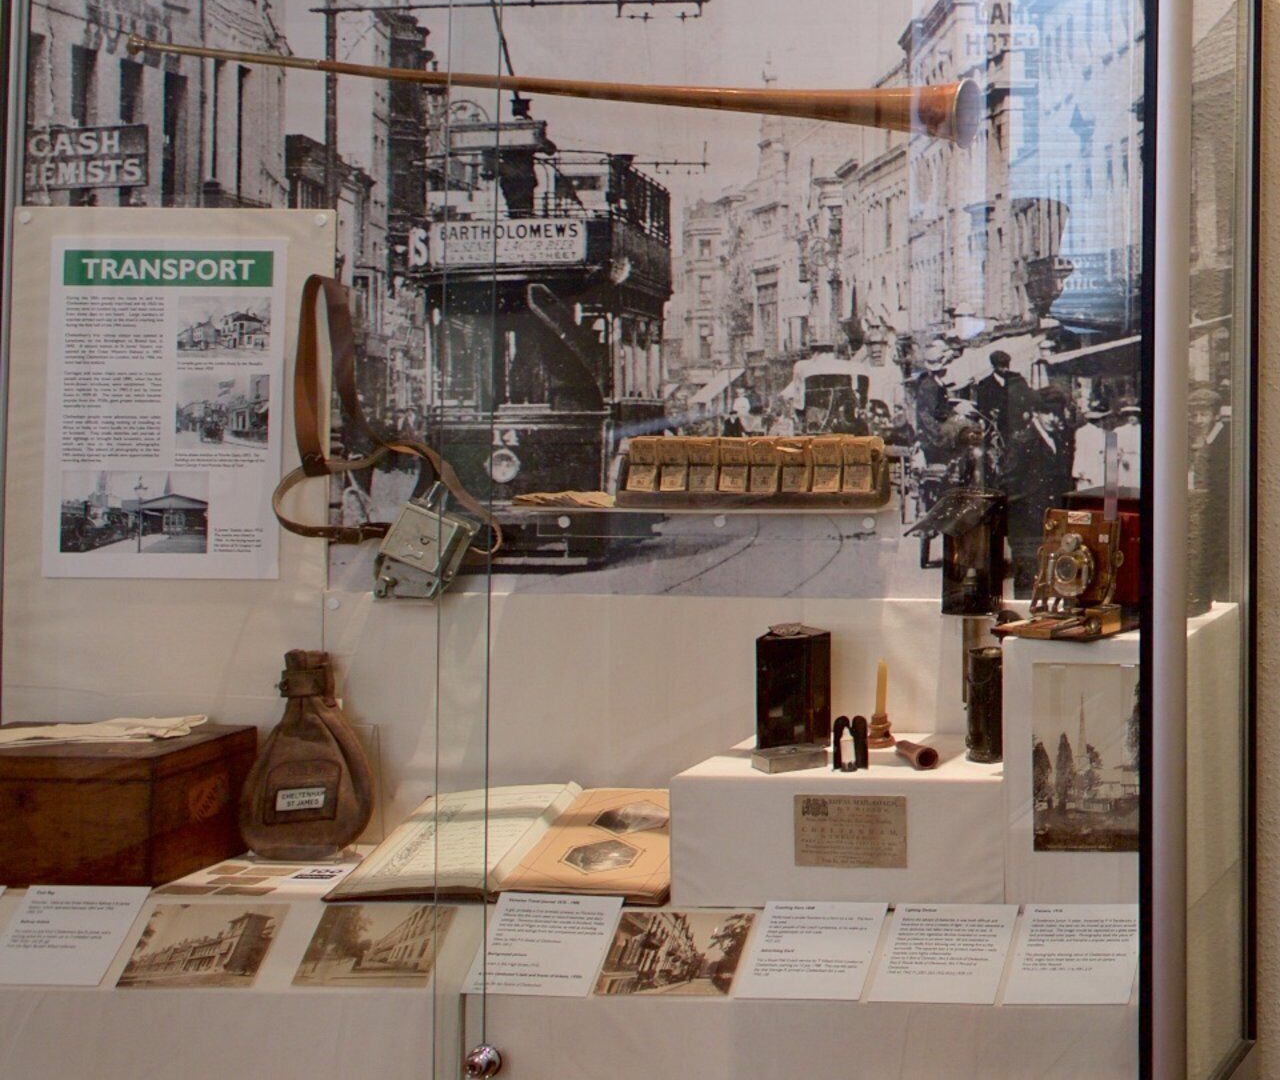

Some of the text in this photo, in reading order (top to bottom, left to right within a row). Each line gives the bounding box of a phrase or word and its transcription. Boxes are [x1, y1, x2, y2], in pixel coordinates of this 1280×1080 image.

[30, 131, 120, 156] CASH
[82, 258, 256, 281] TRANSPORT
[296, 799, 320, 807] JAMES
